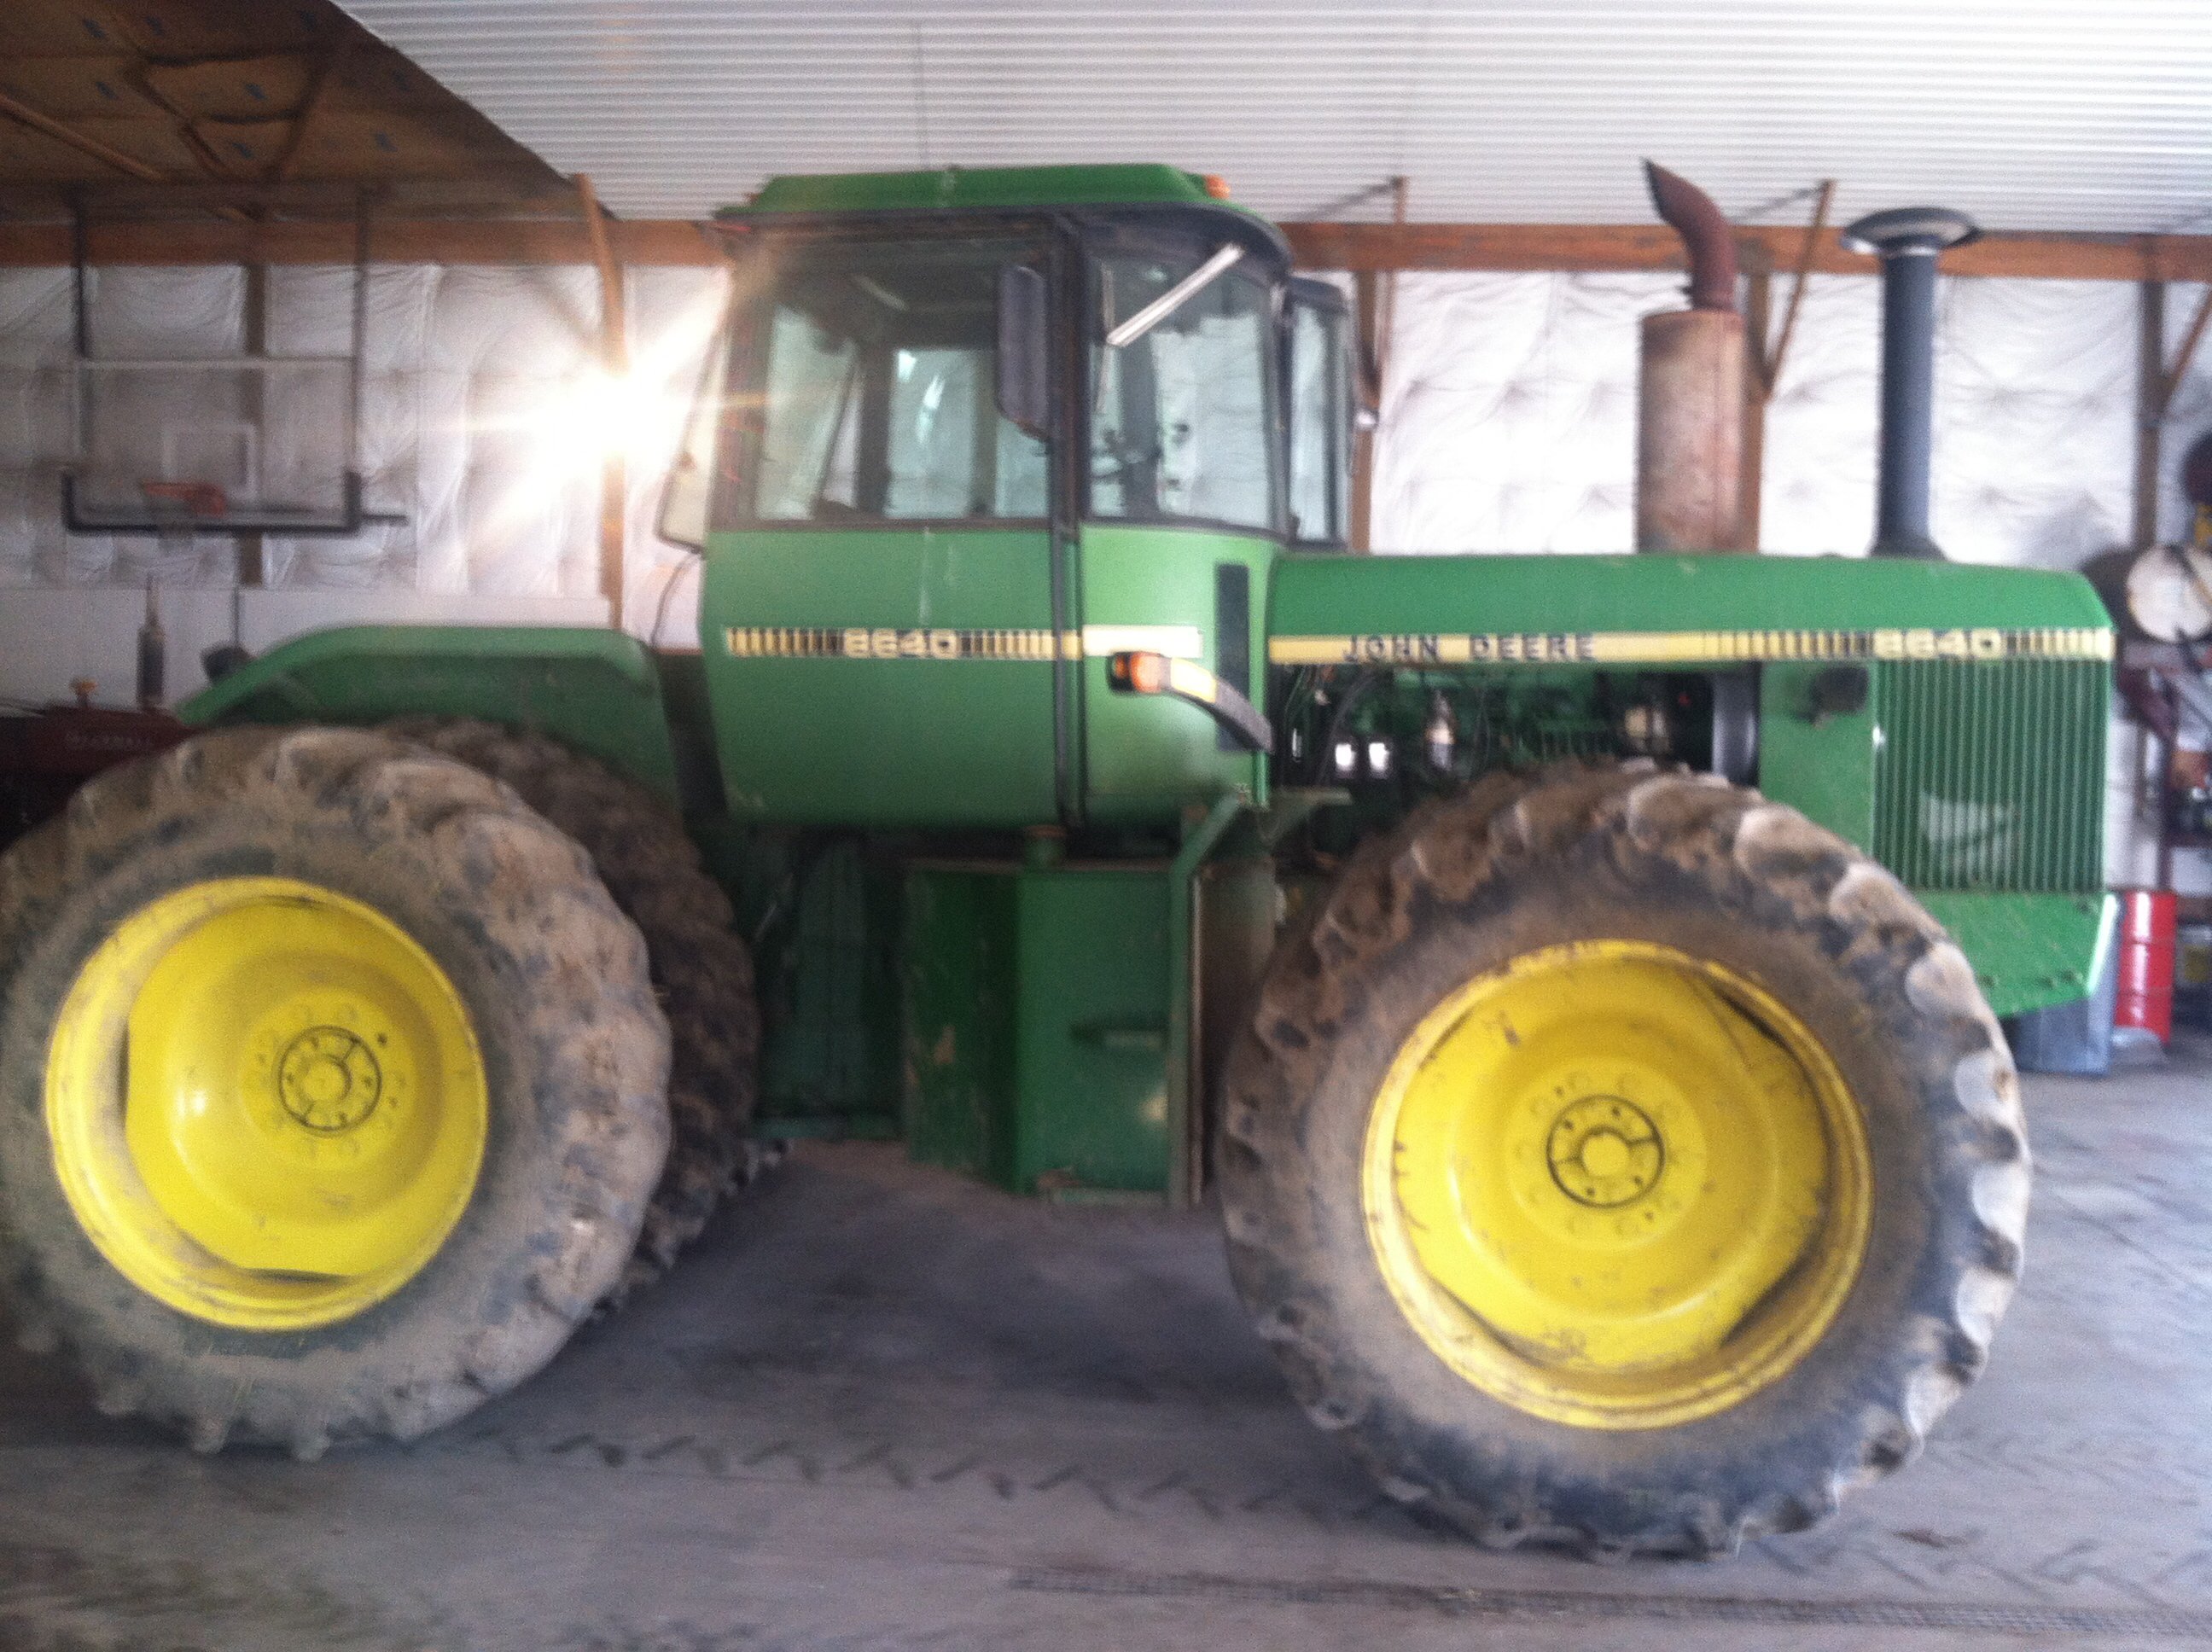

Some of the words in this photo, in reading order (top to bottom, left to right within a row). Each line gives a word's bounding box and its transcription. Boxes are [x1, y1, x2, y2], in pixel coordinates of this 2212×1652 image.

[842, 627, 958, 659] 8640
[1343, 633, 1440, 662] JOHN
[1469, 631, 1596, 660] DEERE
[1873, 627, 2003, 660] 8640
